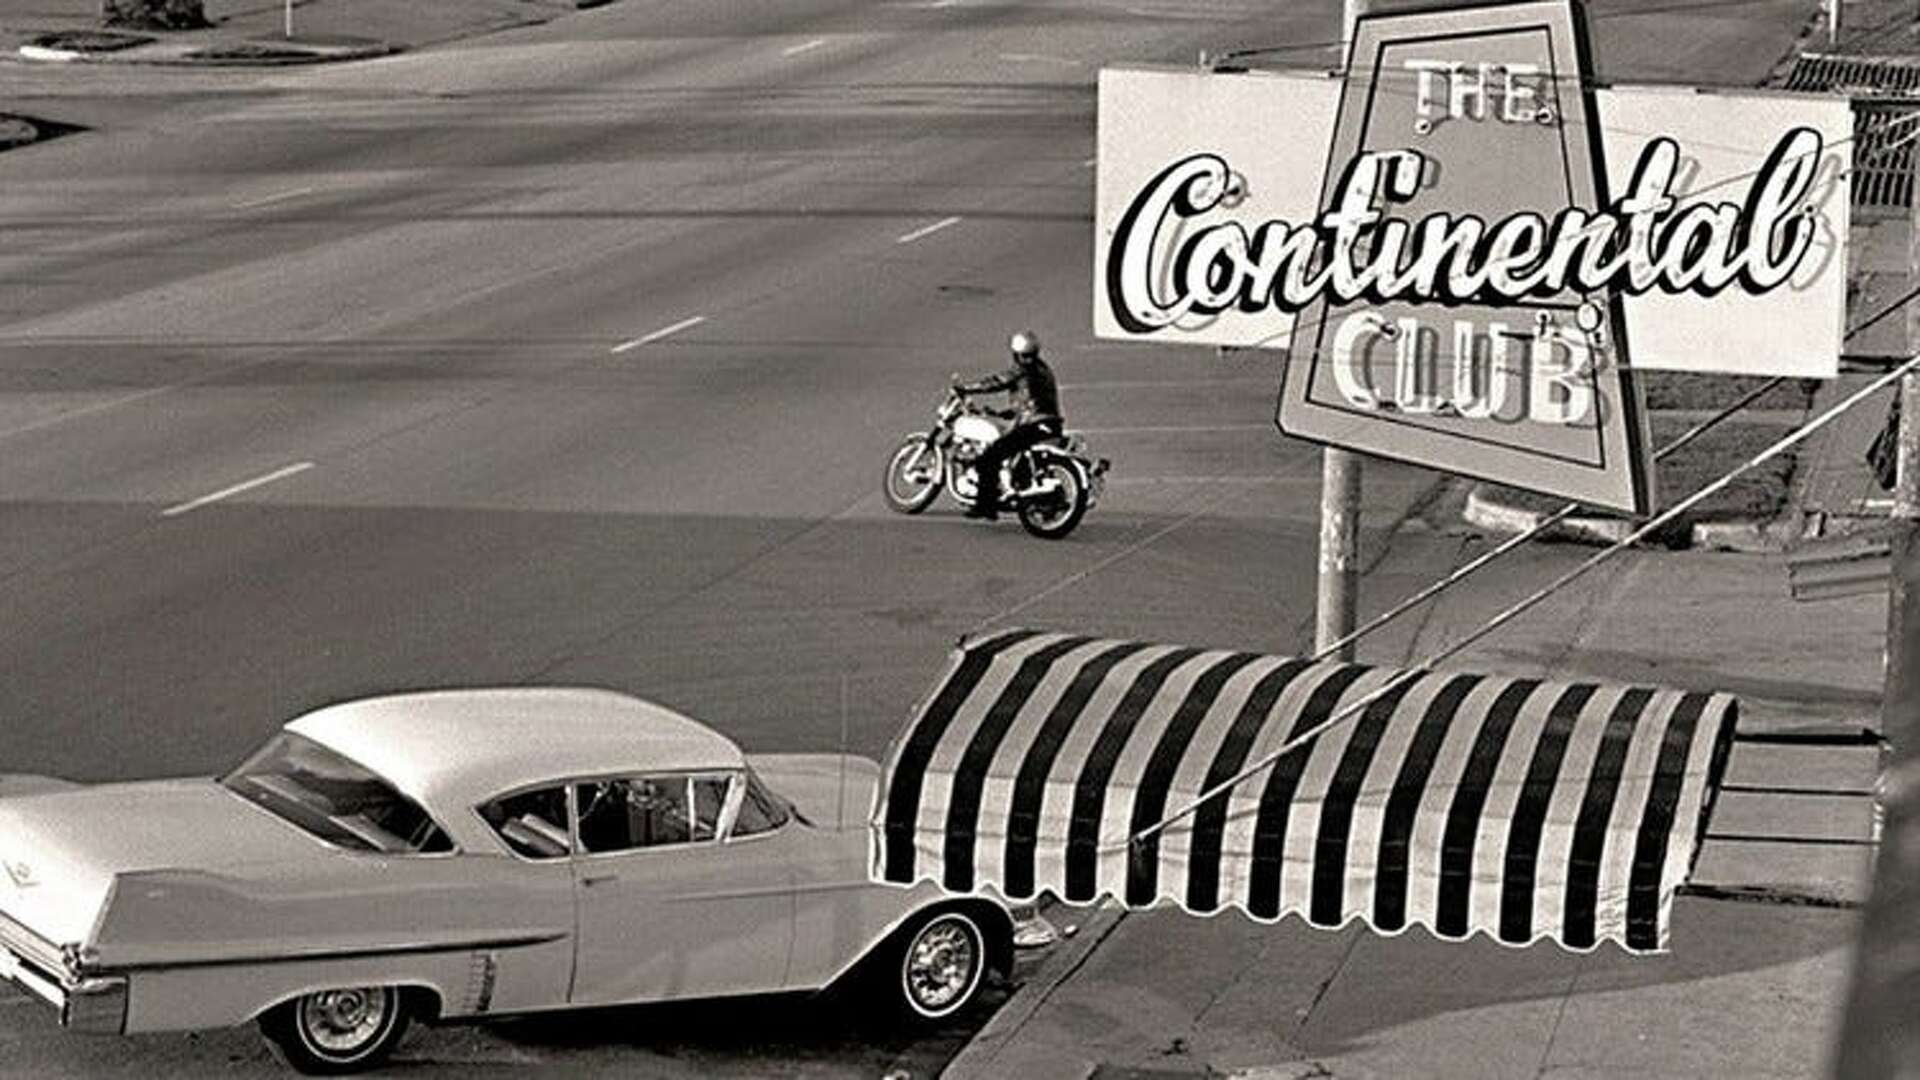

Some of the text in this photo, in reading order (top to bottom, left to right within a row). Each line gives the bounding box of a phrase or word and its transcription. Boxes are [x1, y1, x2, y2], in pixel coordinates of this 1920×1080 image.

[1405, 59, 1554, 126] THE
[1107, 127, 1824, 334] Continental
[1332, 312, 1597, 424] CLUB
